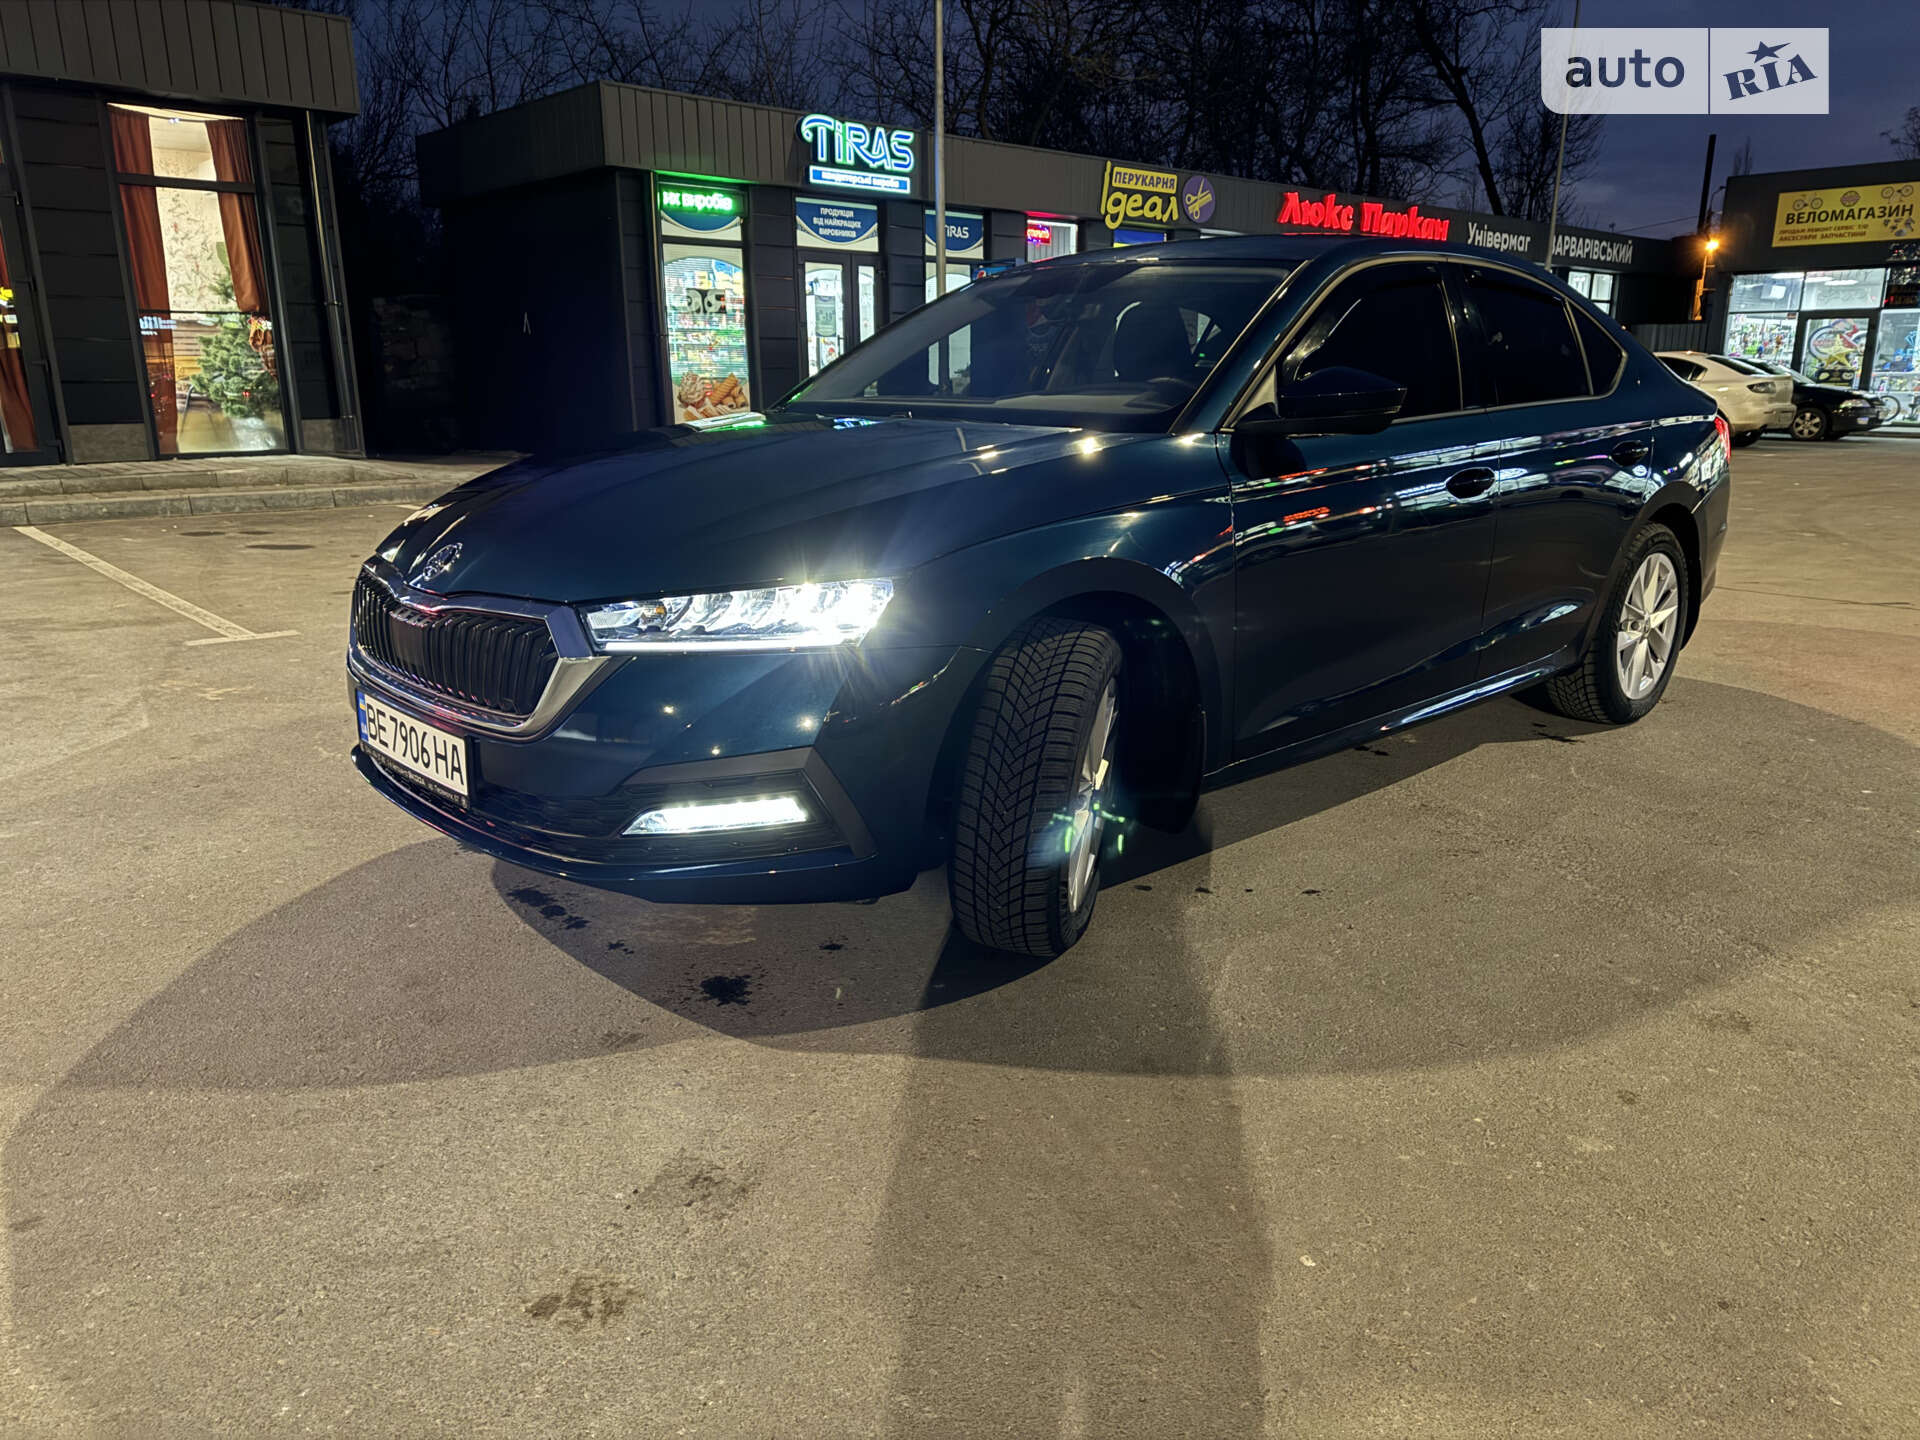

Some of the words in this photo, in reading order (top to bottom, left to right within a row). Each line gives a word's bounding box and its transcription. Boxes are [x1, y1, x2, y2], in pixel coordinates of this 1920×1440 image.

[1115, 171, 1175, 190] ПЕРУКАРНЯ
[1277, 192, 1353, 231] Люкс
[1361, 202, 1449, 241] Паркан
[1785, 204, 1914, 225] ВЕЛОМАГАЗИН
[1467, 222, 1531, 252] Універмаг
